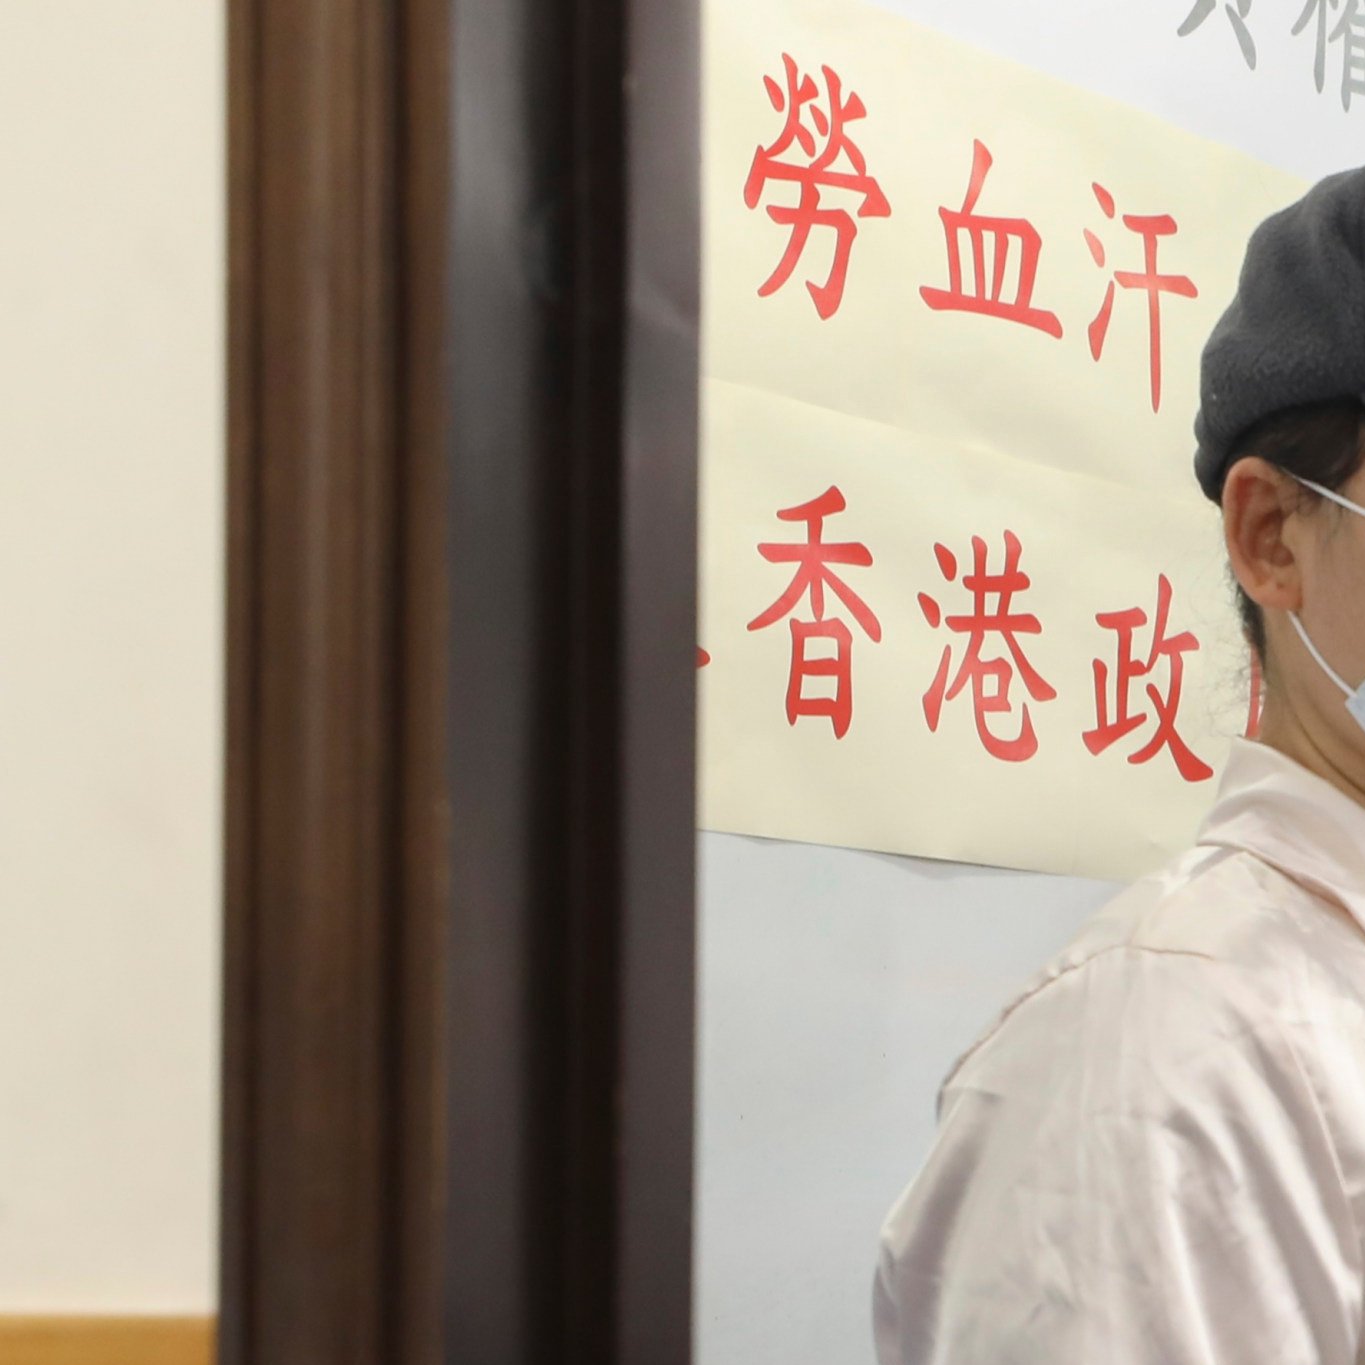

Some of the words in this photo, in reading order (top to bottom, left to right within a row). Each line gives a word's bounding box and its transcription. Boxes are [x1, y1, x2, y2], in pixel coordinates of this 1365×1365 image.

[742, 52, 1199, 414] 勞血汗
[697, 484, 1264, 784] 香港政
